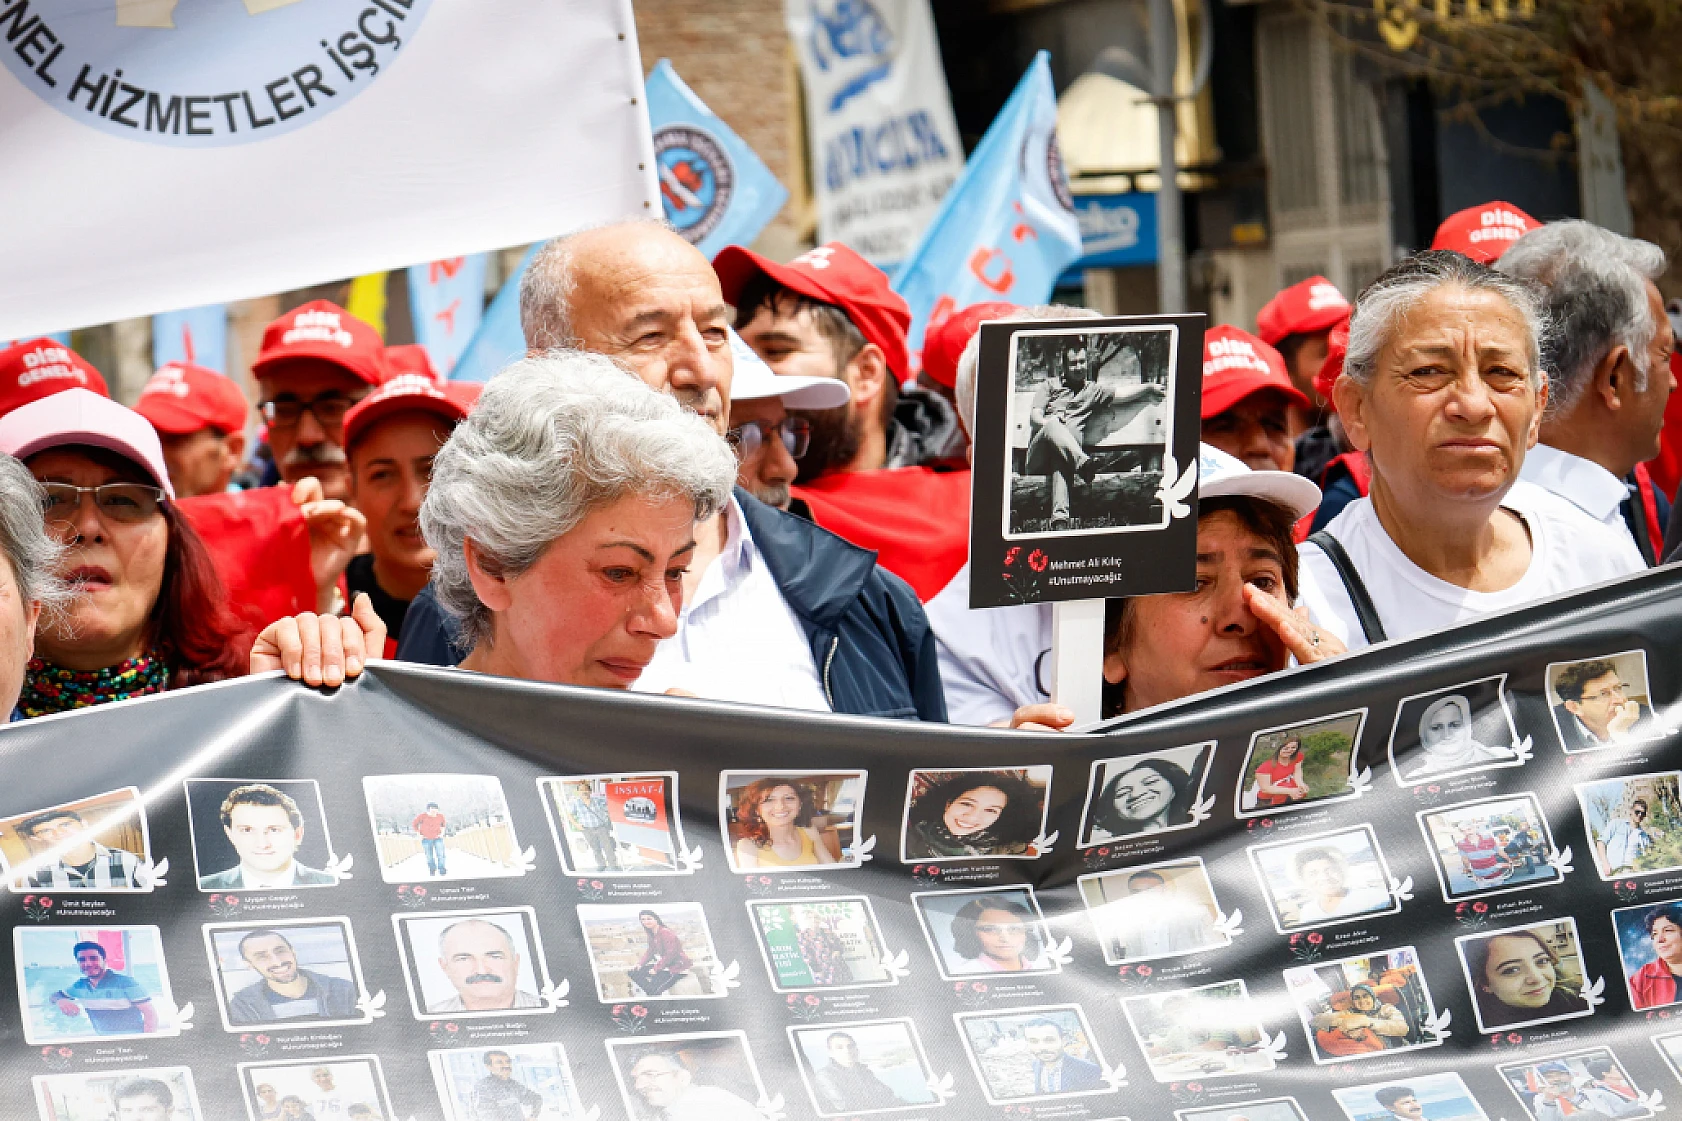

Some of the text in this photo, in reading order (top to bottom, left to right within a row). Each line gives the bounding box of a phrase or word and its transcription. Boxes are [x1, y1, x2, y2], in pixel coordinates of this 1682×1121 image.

[0, 0, 414, 136] NEL HİZMETLER İŞÇİ
[1480, 208, 1527, 230] DİSK
[1208, 337, 1256, 357] DİSK
[23, 347, 72, 369] DİSK
[1049, 559, 1086, 571] Mehmet
[1088, 557, 1100, 568] Ali
[1048, 571, 1122, 586] #Unutmayacağız
[56, 908, 117, 917] #Unutmayacağız
